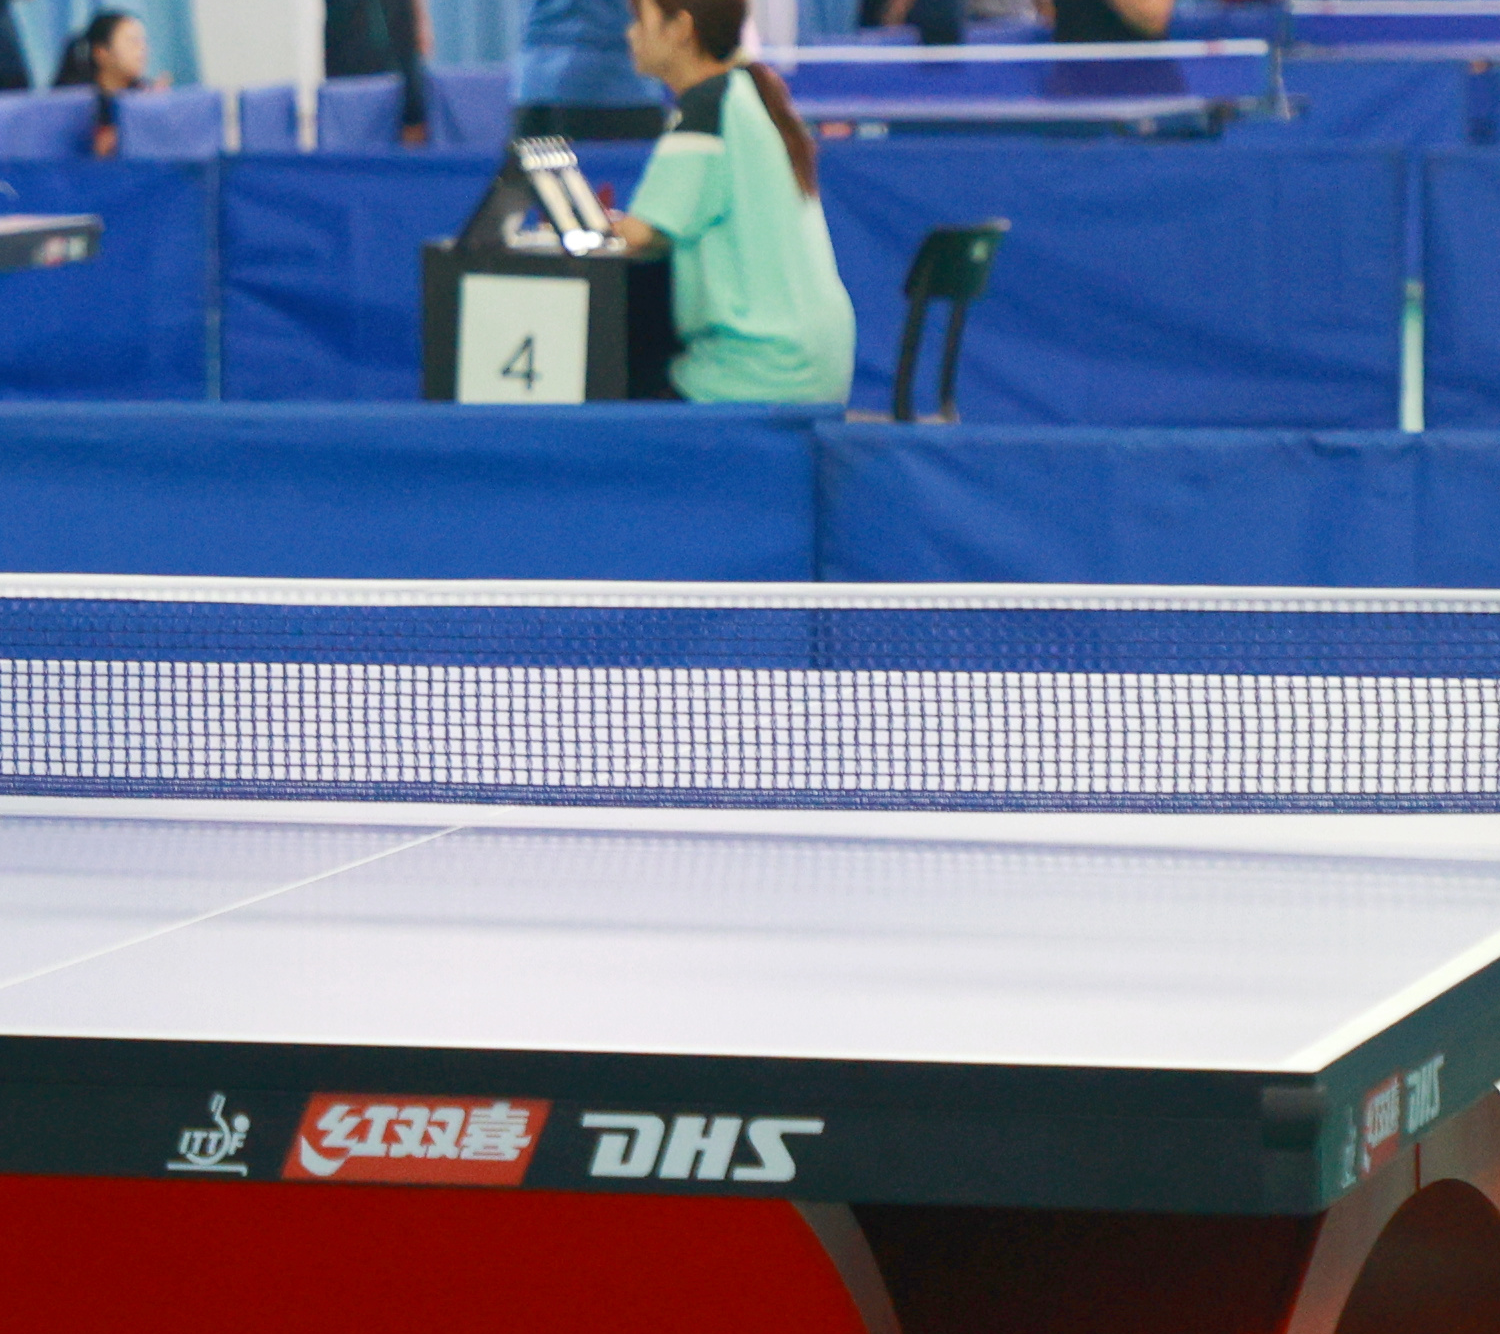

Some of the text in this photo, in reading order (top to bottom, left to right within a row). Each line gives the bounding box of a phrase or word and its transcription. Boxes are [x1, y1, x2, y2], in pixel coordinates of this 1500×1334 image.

[501, 335, 544, 390] 4
[302, 1101, 826, 1183] 红双喜 DHS
